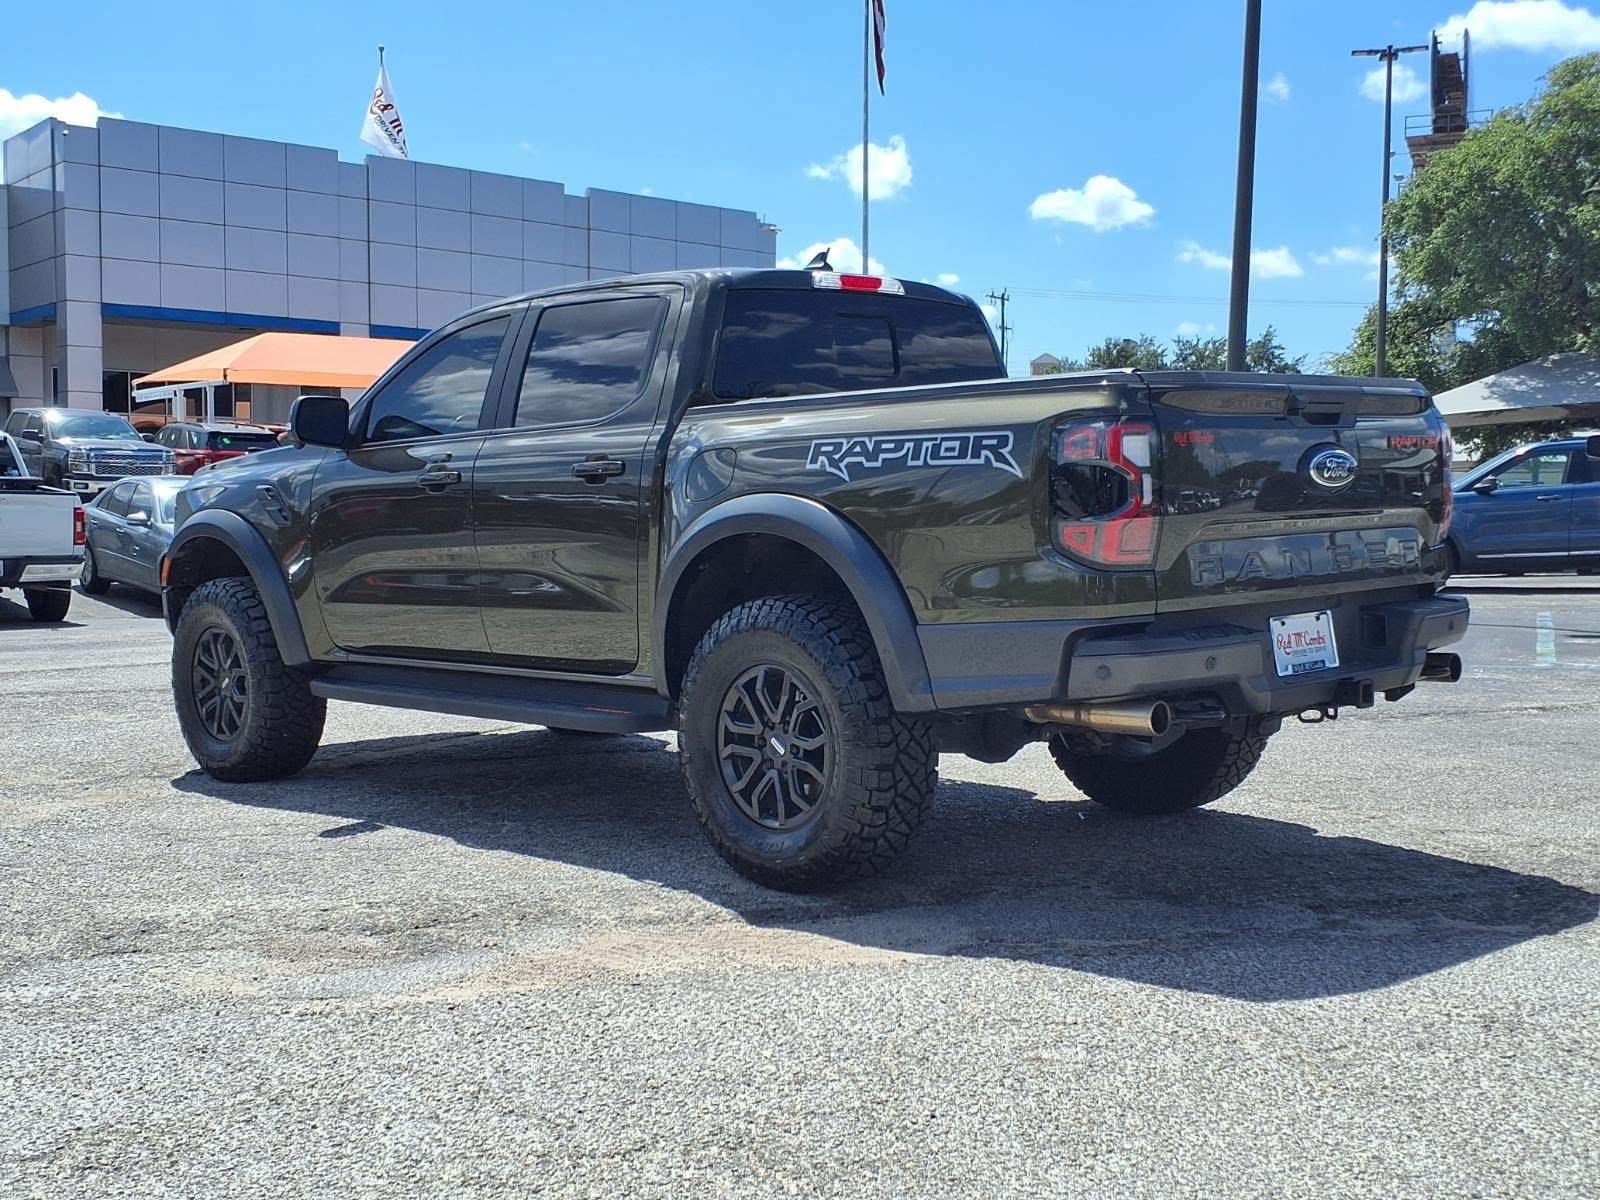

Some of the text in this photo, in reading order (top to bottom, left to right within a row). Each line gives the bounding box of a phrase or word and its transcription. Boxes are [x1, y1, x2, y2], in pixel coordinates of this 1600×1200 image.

[375, 115, 400, 145] DRIVEN
[1391, 435, 1437, 449] RAPTOR
[805, 430, 1024, 482] RAPTOR
[1323, 457, 1349, 478] Ford
[1189, 539, 1421, 587] RANGER
[1277, 633, 1292, 655] Red
